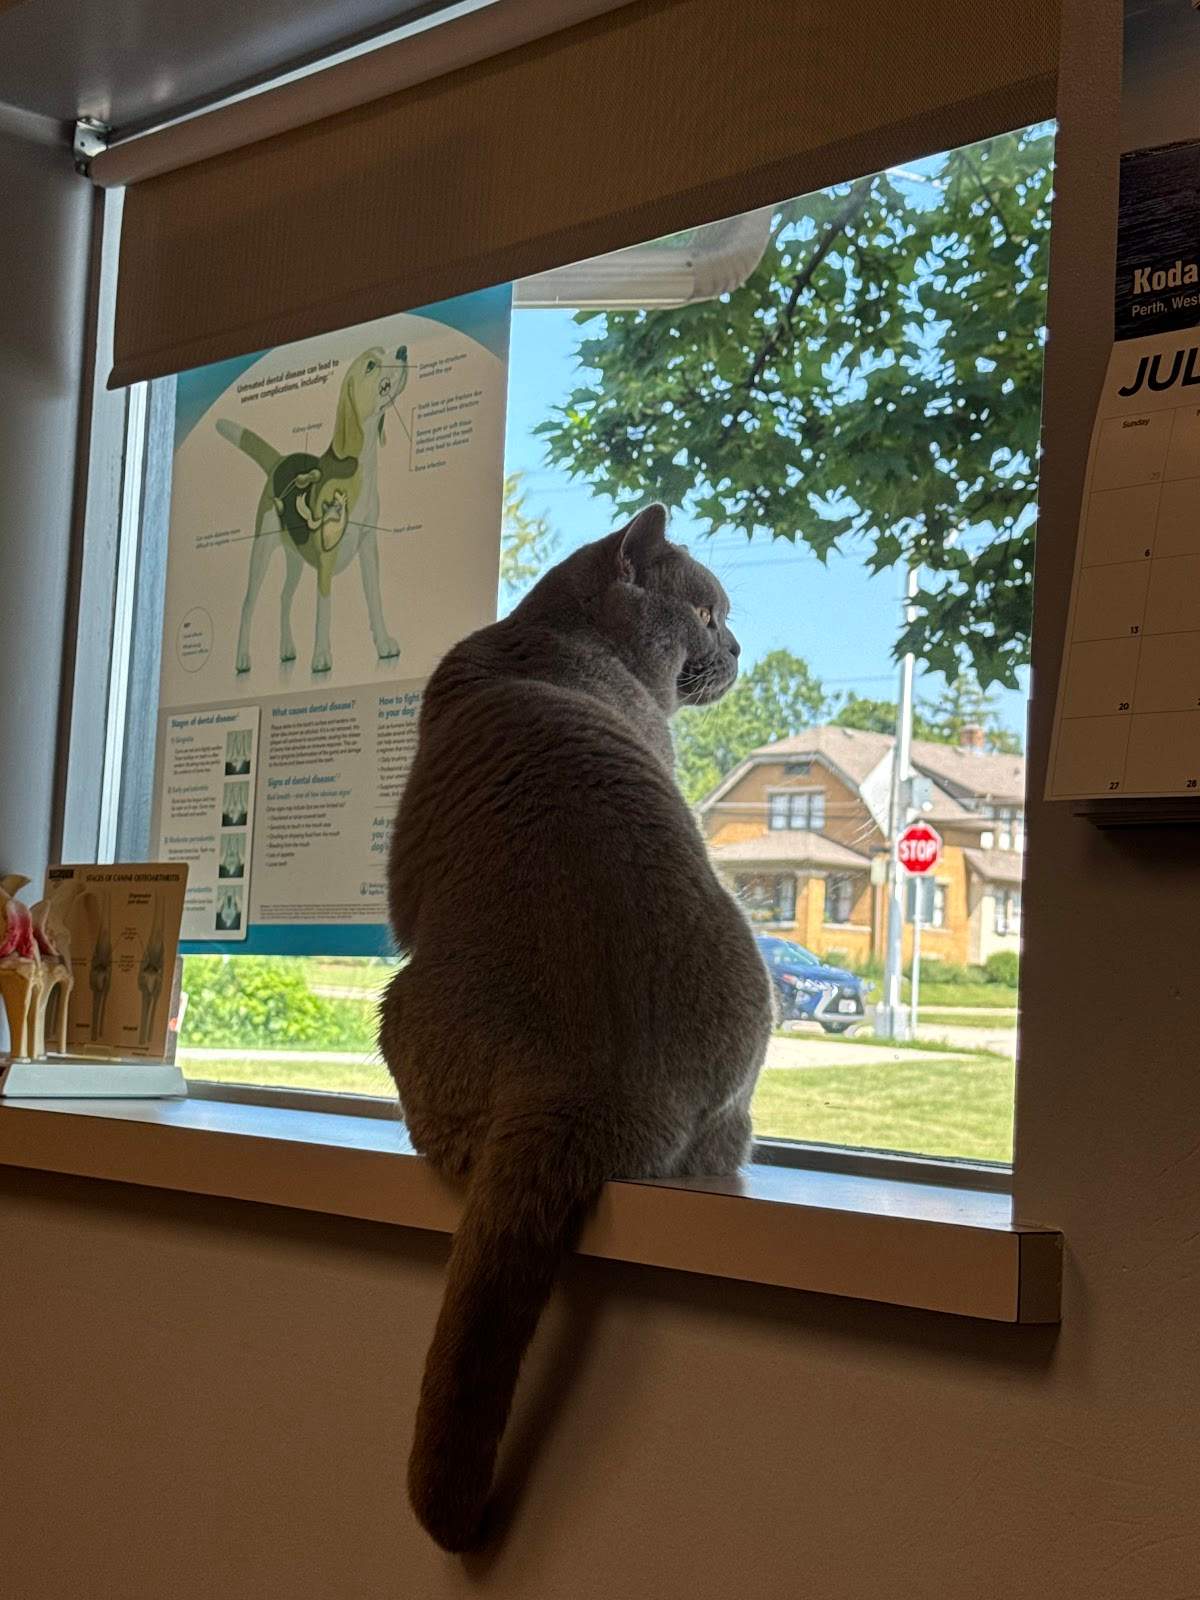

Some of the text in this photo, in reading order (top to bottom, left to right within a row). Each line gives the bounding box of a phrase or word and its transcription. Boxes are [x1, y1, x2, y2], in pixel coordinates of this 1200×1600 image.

[1133, 260, 1198, 295] Koda
[1132, 302, 1168, 317] Perth,
[237, 378, 265, 393] Untreated
[266, 372, 284, 385] dental
[285, 369, 306, 381] disease
[307, 366, 317, 374] can
[318, 360, 331, 371] lead
[1122, 418, 1150, 429] Sunday
[1130, 626, 1140, 635] 13
[379, 696, 394, 705] How
[395, 696, 403, 704] to
[272, 707, 287, 716] What
[309, 704, 328, 713] dental
[1118, 702, 1130, 711] 20
[197, 715, 214, 726] dental
[385, 710, 400, 720] your
[292, 776, 310, 785] dental
[1109, 782, 1120, 790] 27
[900, 839, 937, 862] STOP
